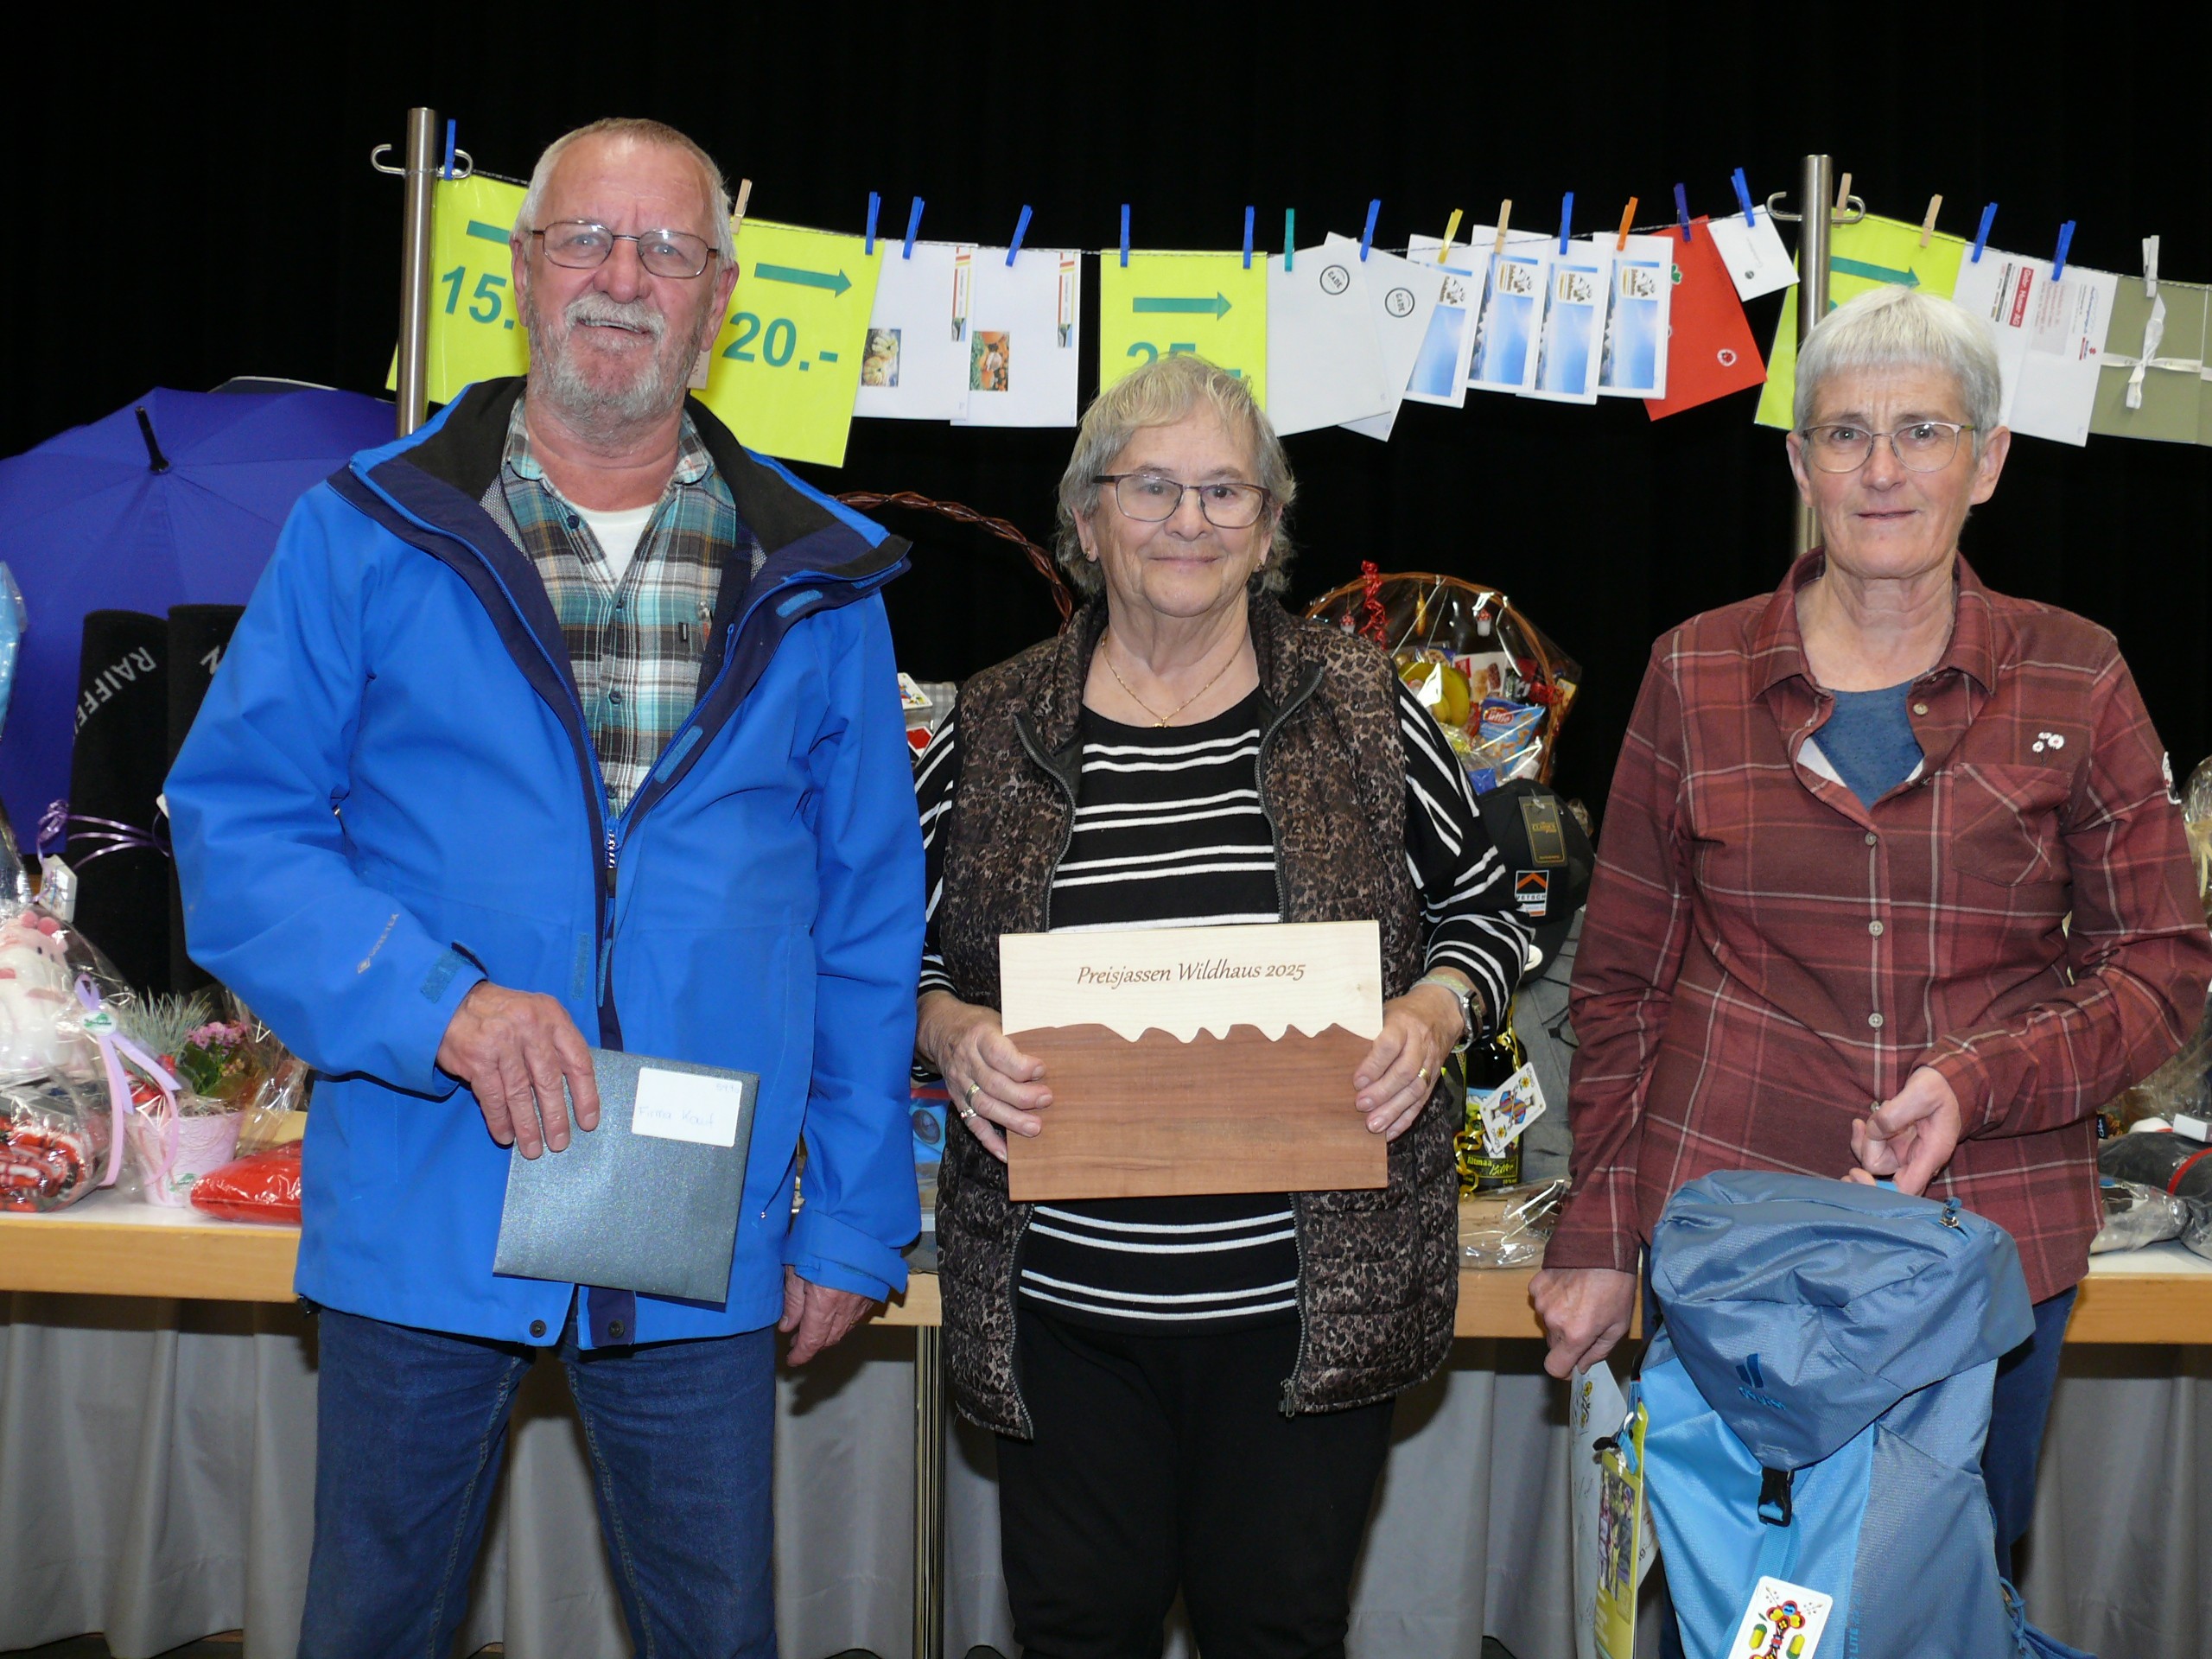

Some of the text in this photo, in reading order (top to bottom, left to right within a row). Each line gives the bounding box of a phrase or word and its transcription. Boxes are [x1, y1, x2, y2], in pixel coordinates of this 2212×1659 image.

[721, 311, 838, 371] 20.-
[1077, 958, 1306, 989] Preisjassen Wildhaus 2025
[1848, 1627, 1859, 1653] LITE
